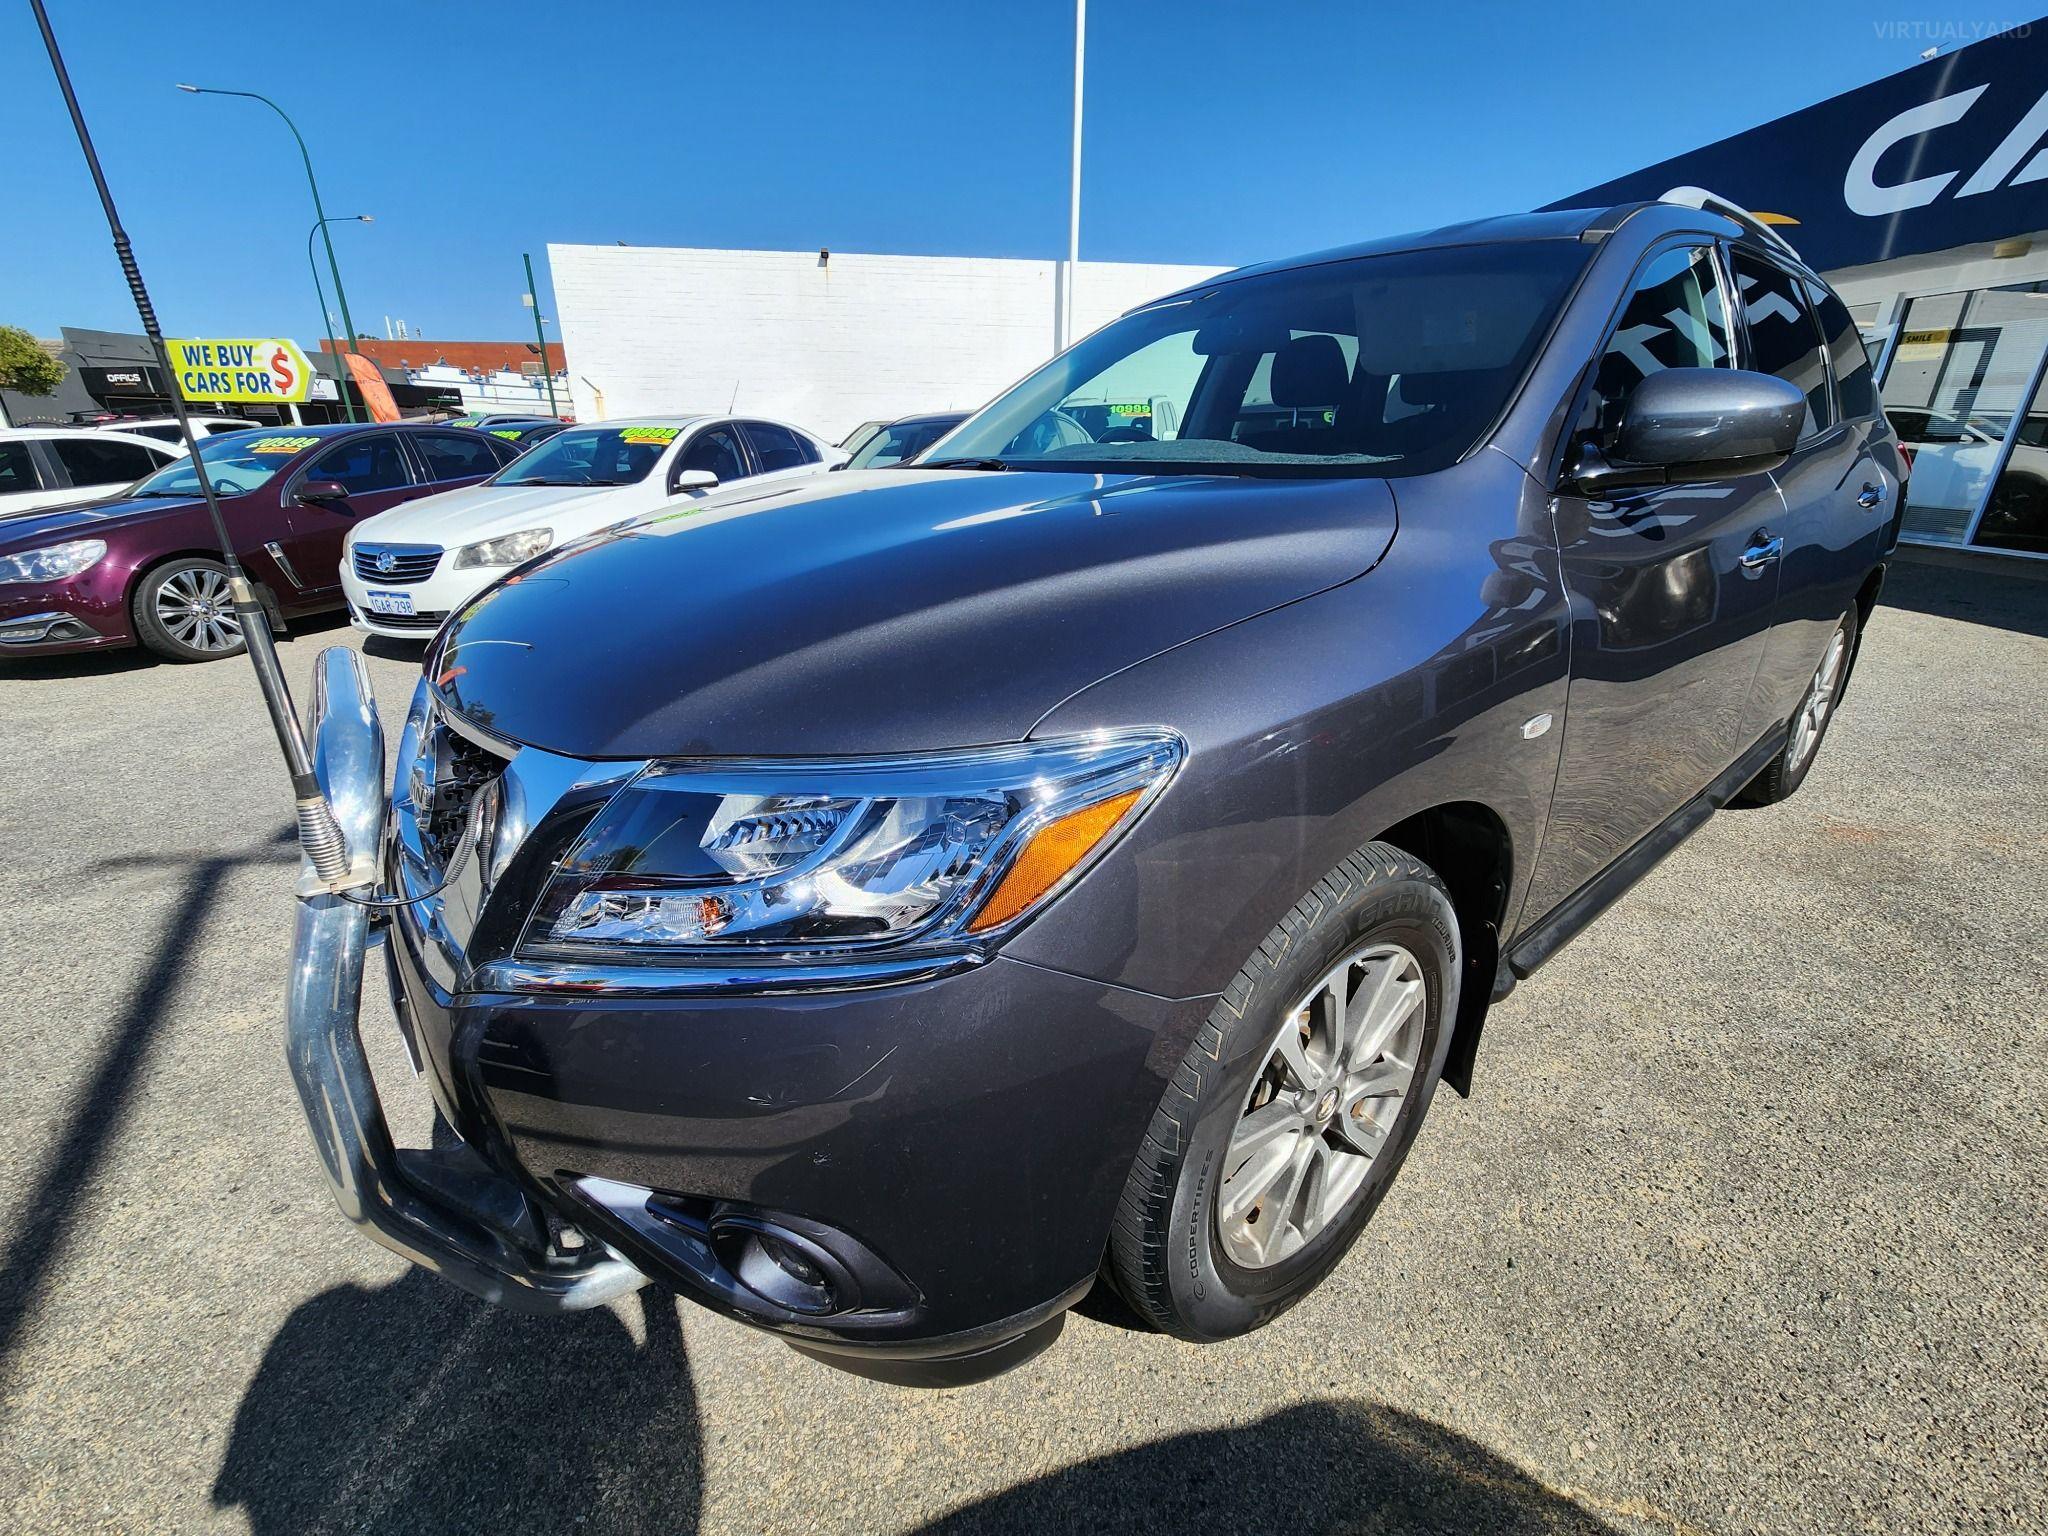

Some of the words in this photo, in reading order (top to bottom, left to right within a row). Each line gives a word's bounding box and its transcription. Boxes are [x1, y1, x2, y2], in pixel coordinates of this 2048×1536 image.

[1905, 333, 1934, 344] SMILE
[181, 344, 213, 367] WE
[219, 345, 254, 367] BUY
[184, 372, 233, 394] CARS
[237, 372, 274, 394] FOR
[1110, 404, 1151, 414] 10999
[1431, 915, 1457, 964] TOURING
[1190, 1148, 1215, 1279] COOPERTIRES
